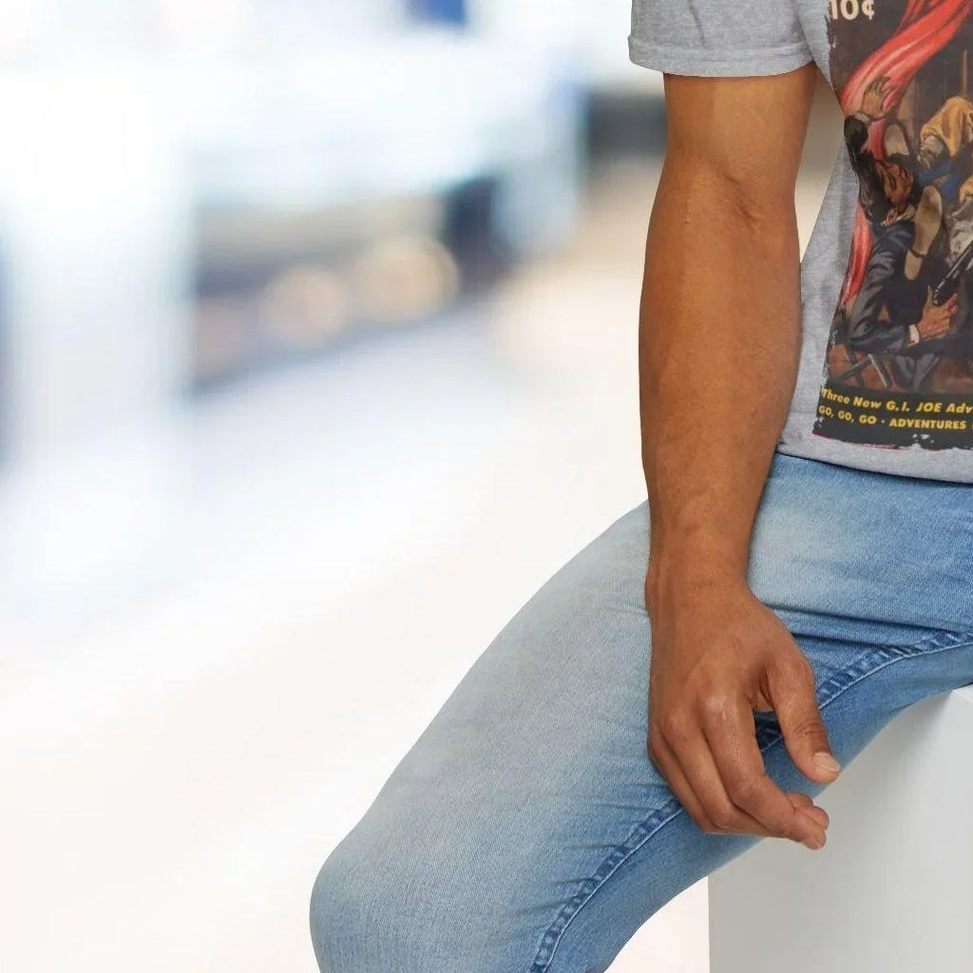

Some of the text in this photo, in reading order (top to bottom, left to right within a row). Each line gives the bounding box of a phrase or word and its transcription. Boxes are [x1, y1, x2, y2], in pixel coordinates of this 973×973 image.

[821, 388, 850, 405] Three
[853, 396, 882, 409] New
[915, 402, 942, 413] JOE
[818, 405, 834, 417] GO,
[838, 410, 855, 423] GO,
[859, 414, 877, 425] GO
[889, 418, 967, 430] ADVENTURES
